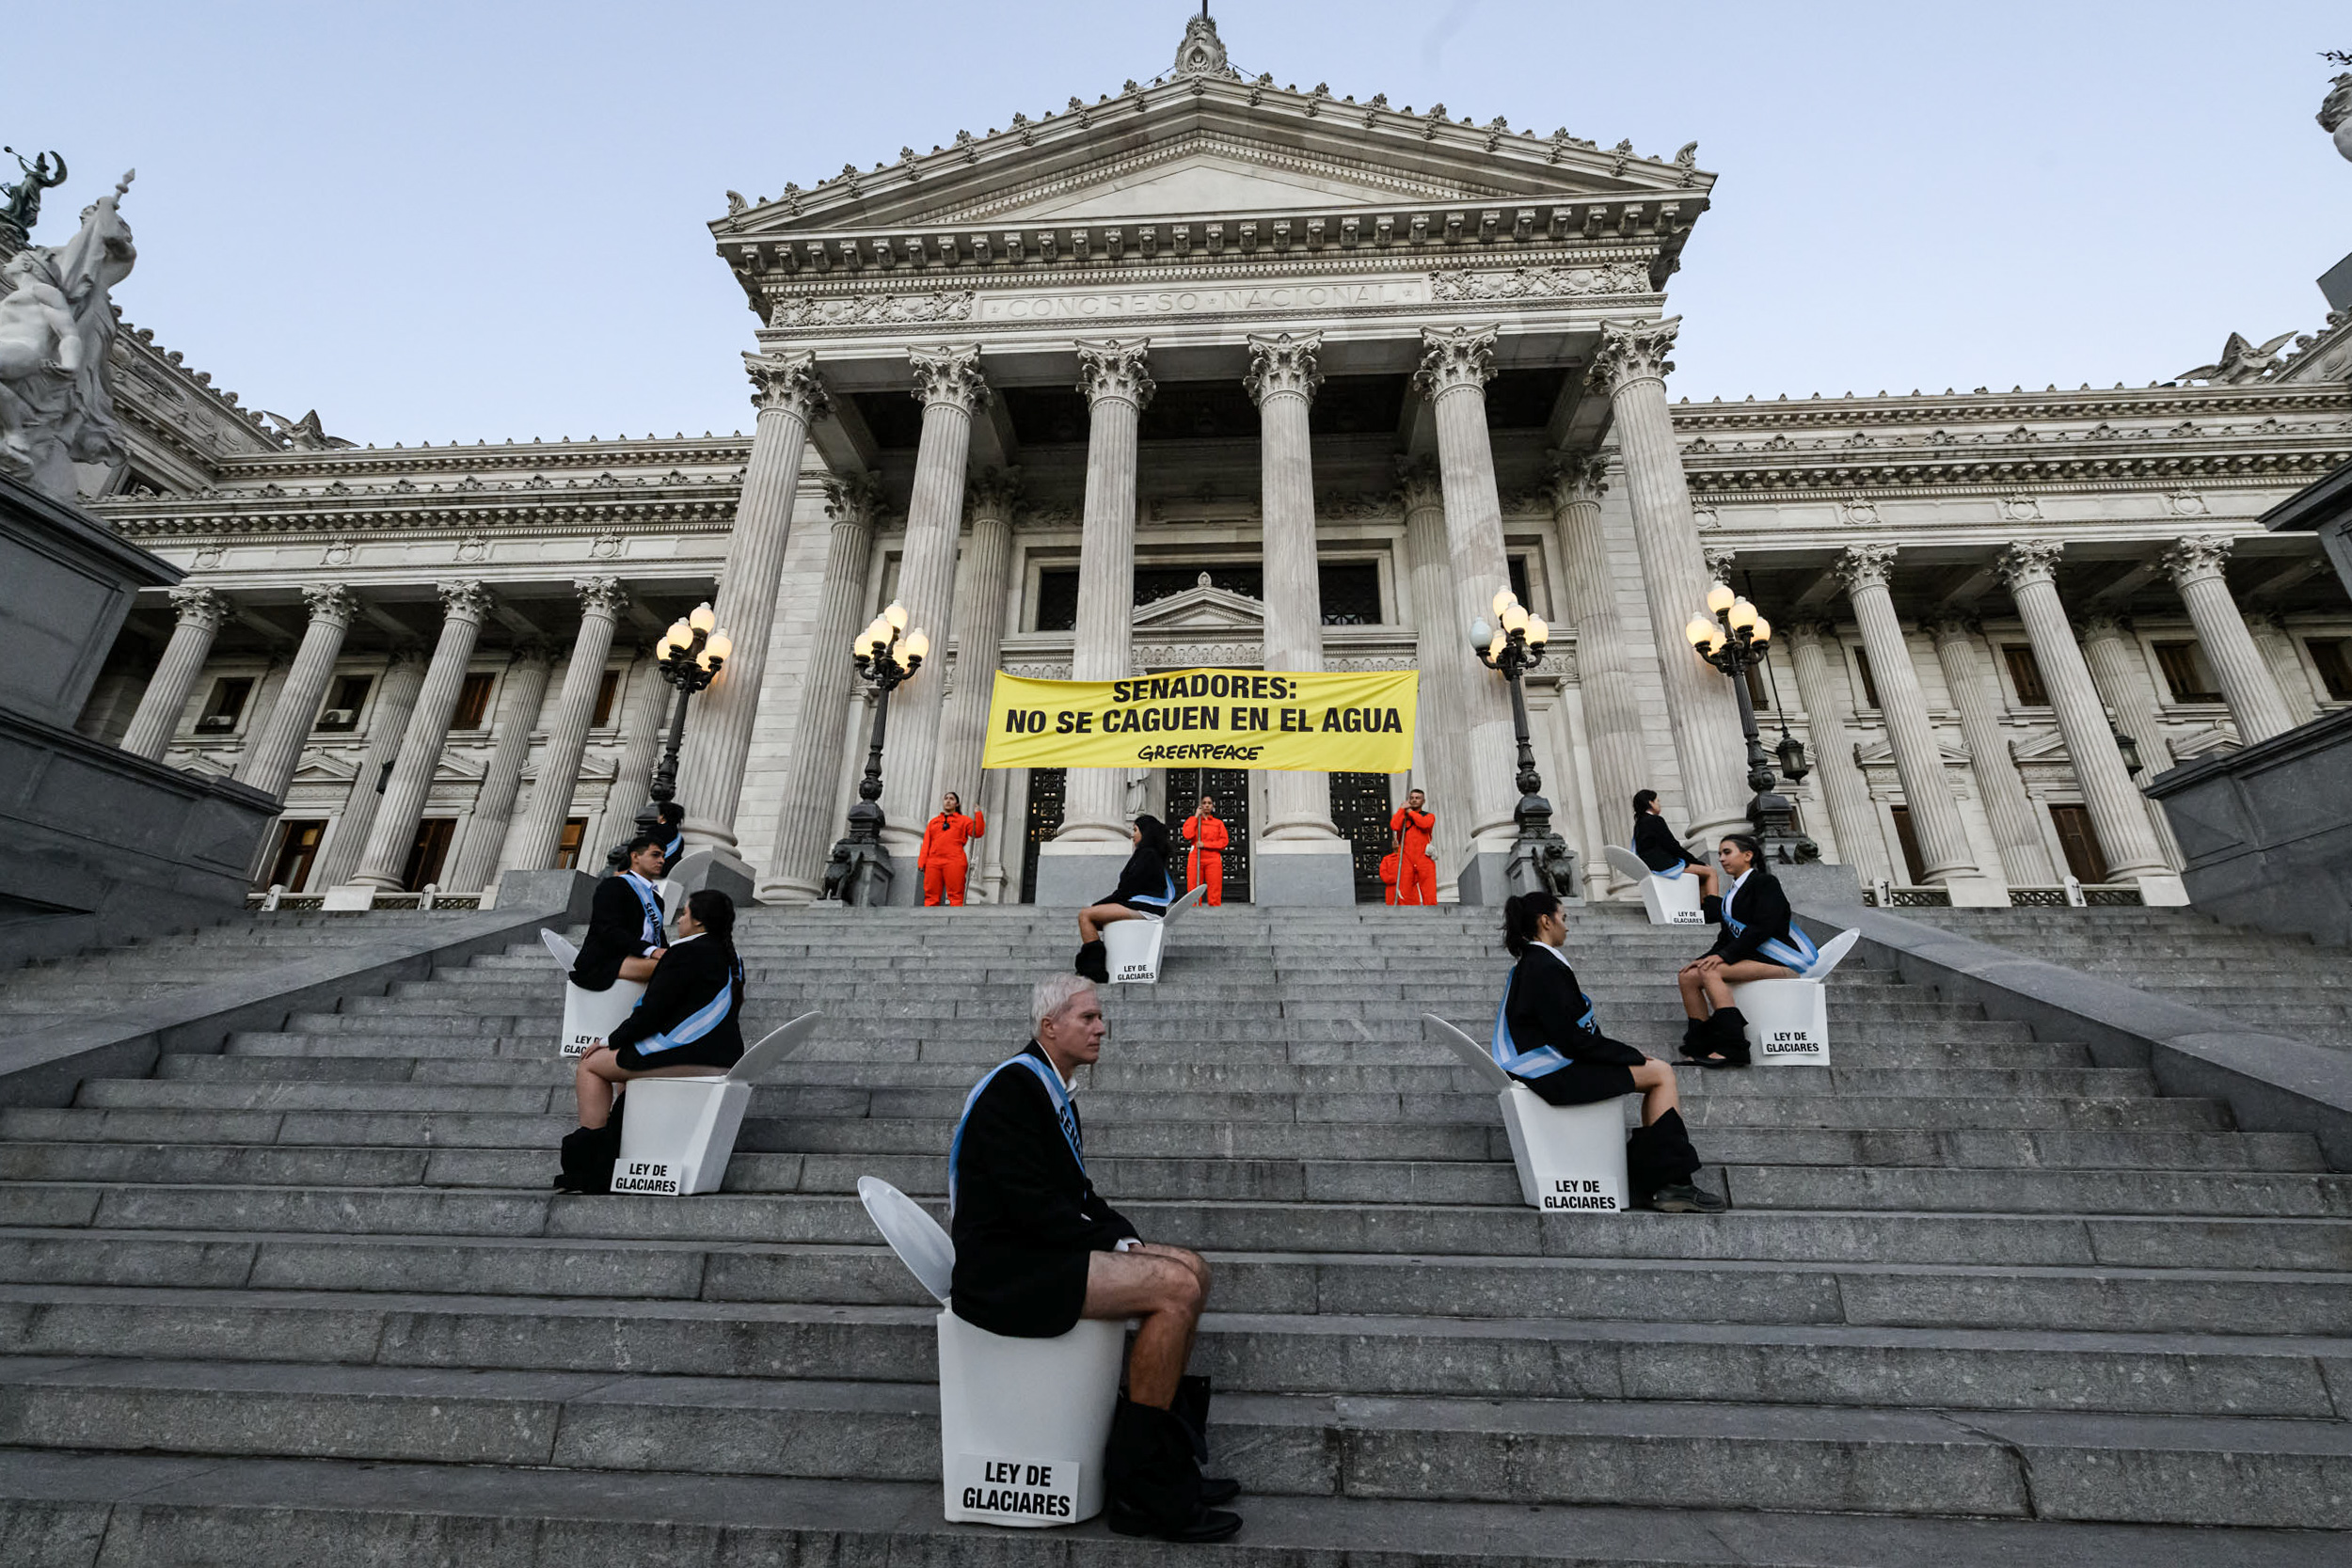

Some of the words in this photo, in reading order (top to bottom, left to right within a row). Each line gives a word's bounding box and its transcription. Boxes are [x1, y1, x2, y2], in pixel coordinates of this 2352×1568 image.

[1008, 293, 1199, 318] CONGRESO
[1223, 285, 1396, 309] NACIONAL
[1112, 673, 1296, 704] SENADORES:
[1006, 709, 1046, 734] NO
[1056, 710, 1093, 734] SE
[1103, 706, 1219, 734] CAGUEN
[1231, 706, 1269, 731] EN
[1280, 708, 1313, 733] EL
[1321, 707, 1403, 733] AGUA
[1137, 743, 1263, 762] GREENPEACE
[575, 1036, 592, 1044] LEY
[1773, 1032, 1790, 1041] LEY
[1794, 1032, 1807, 1041] DE
[1766, 1042, 1820, 1053] GLACIARES
[629, 1164, 650, 1175] LEY
[652, 1164, 667, 1177] DE
[615, 1178, 676, 1193] GLACIARES
[1555, 1180, 1579, 1193] LEY
[1582, 1180, 1600, 1193] DE
[1544, 1196, 1616, 1210] GLACIARES
[985, 1462, 1021, 1484] LEY
[1025, 1465, 1052, 1487] DE
[962, 1487, 1071, 1517] GLACIARES
